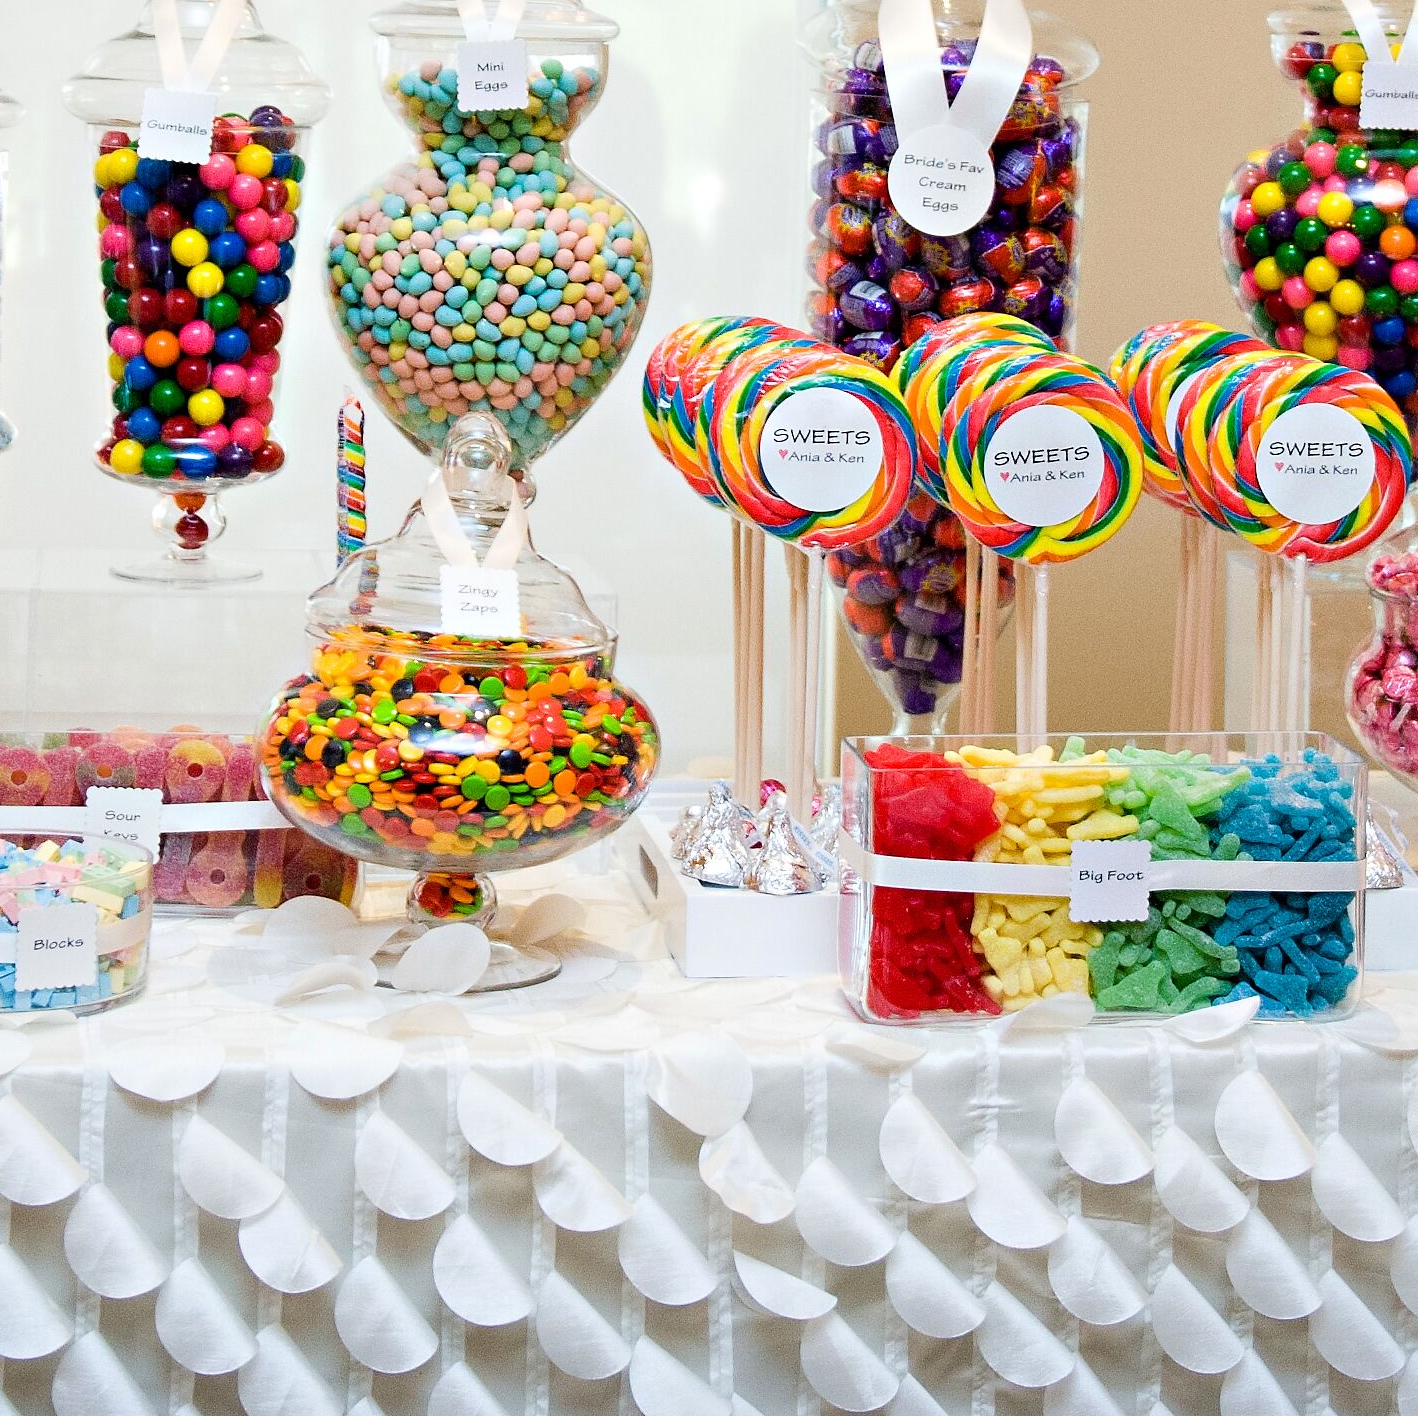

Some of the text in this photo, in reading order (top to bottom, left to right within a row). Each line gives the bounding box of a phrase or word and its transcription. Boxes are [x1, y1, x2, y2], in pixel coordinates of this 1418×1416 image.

[477, 62, 504, 72] Mini
[474, 80, 508, 92] Eggs
[147, 119, 208, 136] Gumballs
[903, 154, 985, 174] Bride's Fav
[918, 176, 967, 192] Cream
[922, 196, 959, 213] Eggs
[772, 428, 871, 446] SWEETS
[994, 446, 1090, 466] SWEETS
[1268, 441, 1364, 458] SWEETS
[788, 451, 865, 464] Ania & Ken
[1010, 470, 1085, 483] Ania & Ken
[1284, 464, 1358, 476] Ania & Ken
[458, 584, 499, 598] Zingy
[460, 601, 499, 616] Zaps
[104, 810, 141, 821] Sour
[1079, 870, 1144, 884] Big Foot
[33, 936, 84, 951] Blocks
